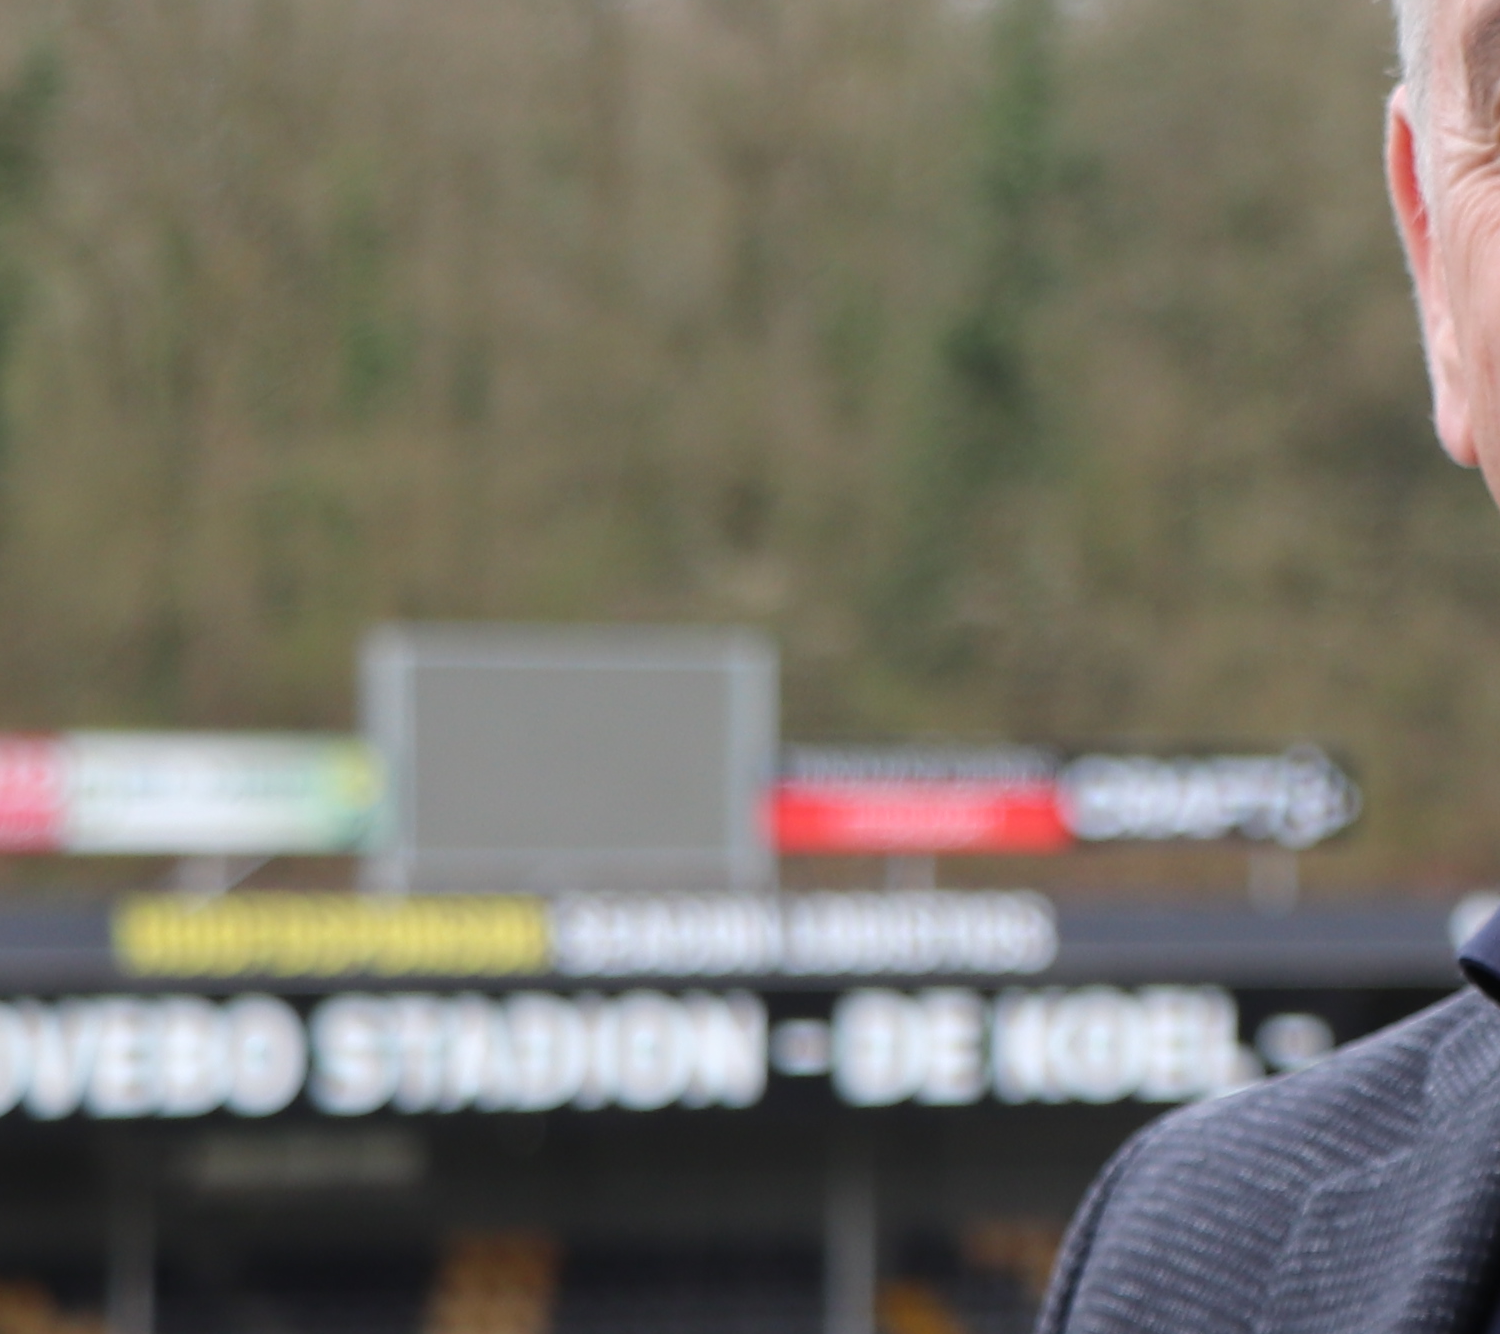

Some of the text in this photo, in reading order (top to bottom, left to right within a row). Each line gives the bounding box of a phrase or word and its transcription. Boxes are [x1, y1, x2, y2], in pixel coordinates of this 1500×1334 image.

[310, 989, 768, 1113] STADION
[833, 989, 986, 1107] DE
[990, 985, 1250, 1107] KOEL
